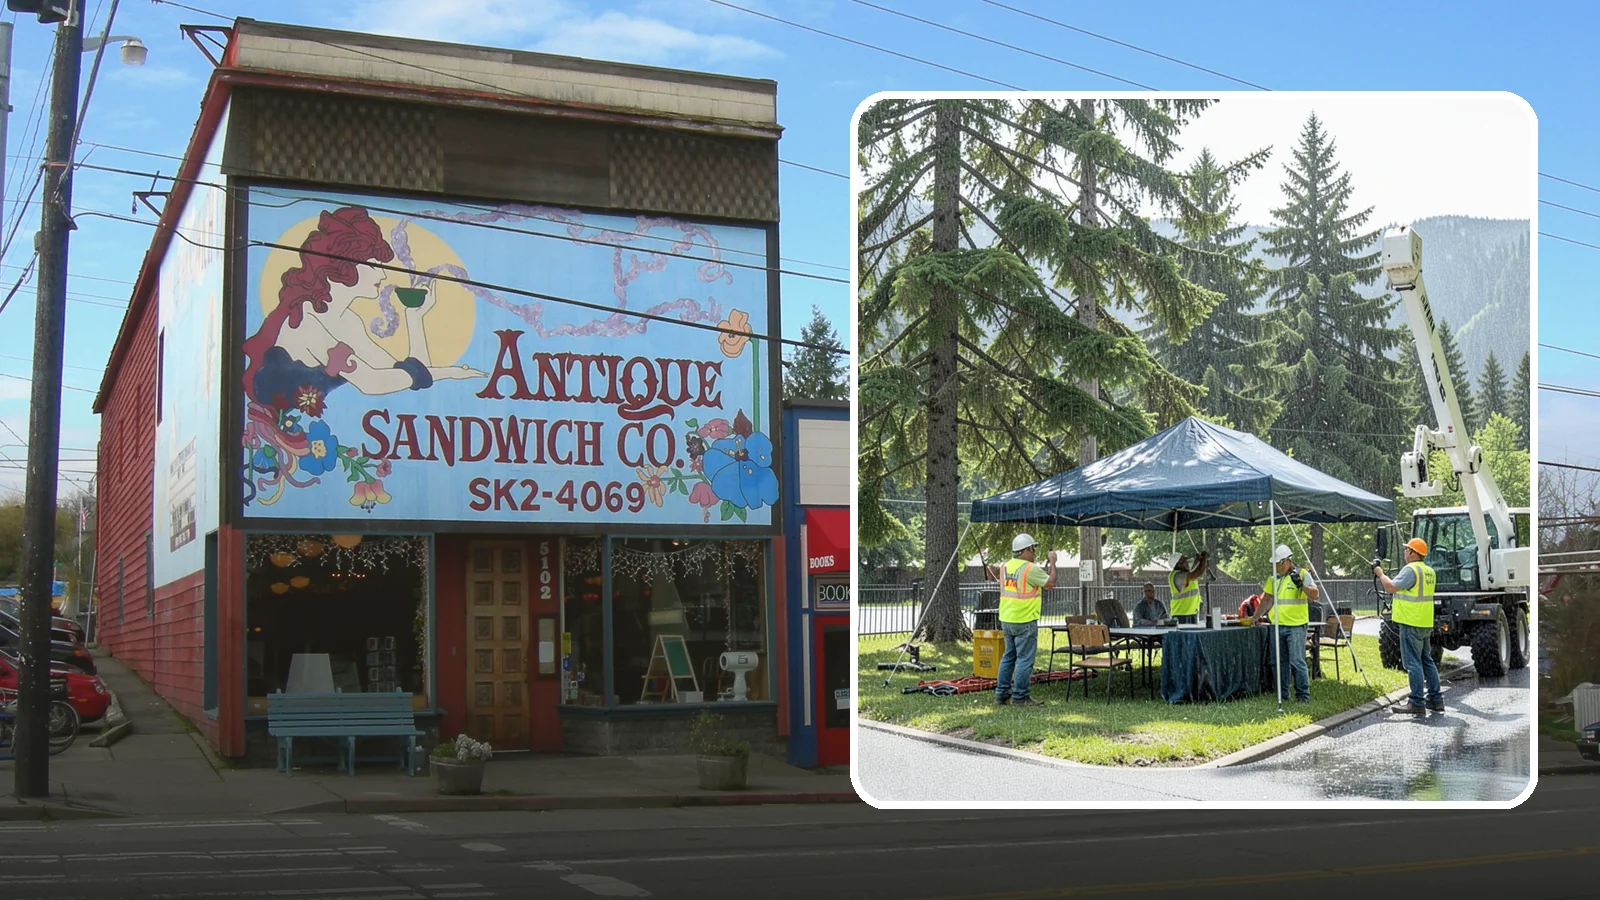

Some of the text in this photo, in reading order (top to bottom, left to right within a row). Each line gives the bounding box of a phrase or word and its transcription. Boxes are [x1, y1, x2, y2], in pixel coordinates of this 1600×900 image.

[476, 328, 725, 421] ANTIQUE
[361, 408, 685, 469] SANDWICH CO.
[468, 476, 646, 513] SK2-4069
[540, 541, 551, 600] 5102
[809, 555, 835, 569] BOOKS
